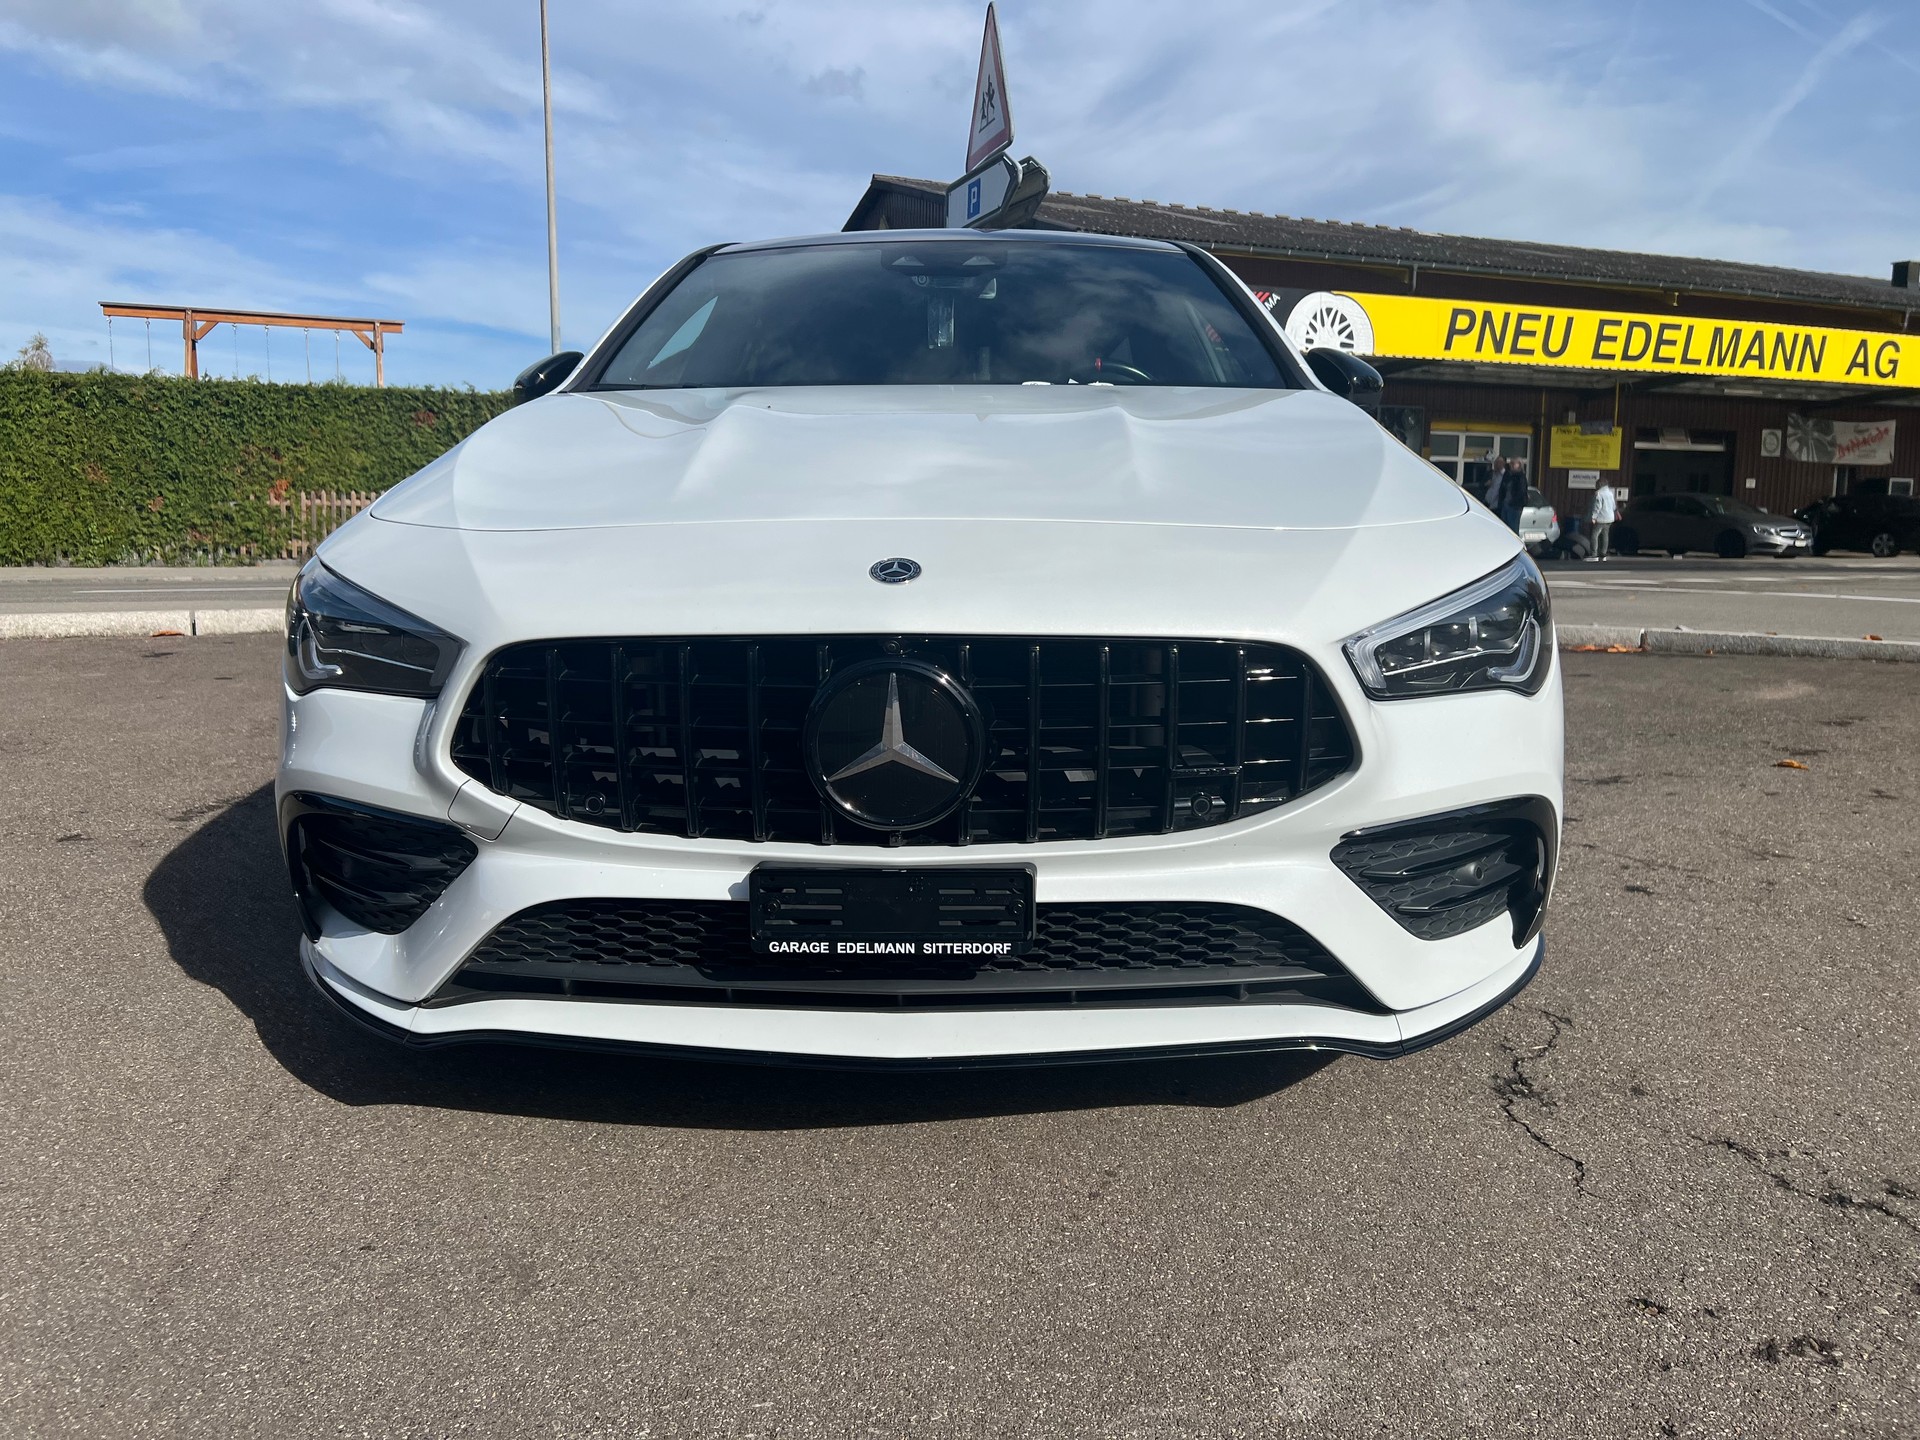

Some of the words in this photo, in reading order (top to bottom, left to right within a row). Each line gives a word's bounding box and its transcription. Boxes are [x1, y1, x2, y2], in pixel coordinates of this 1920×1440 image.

[970, 187, 978, 214] P
[1443, 307, 1575, 359] PNEU
[1591, 318, 1828, 374] EDELMANN
[1844, 338, 1901, 379] AG
[768, 941, 830, 953] GARAGE
[837, 942, 916, 954] EDELMANN
[922, 942, 1012, 955] SITTERDORF
